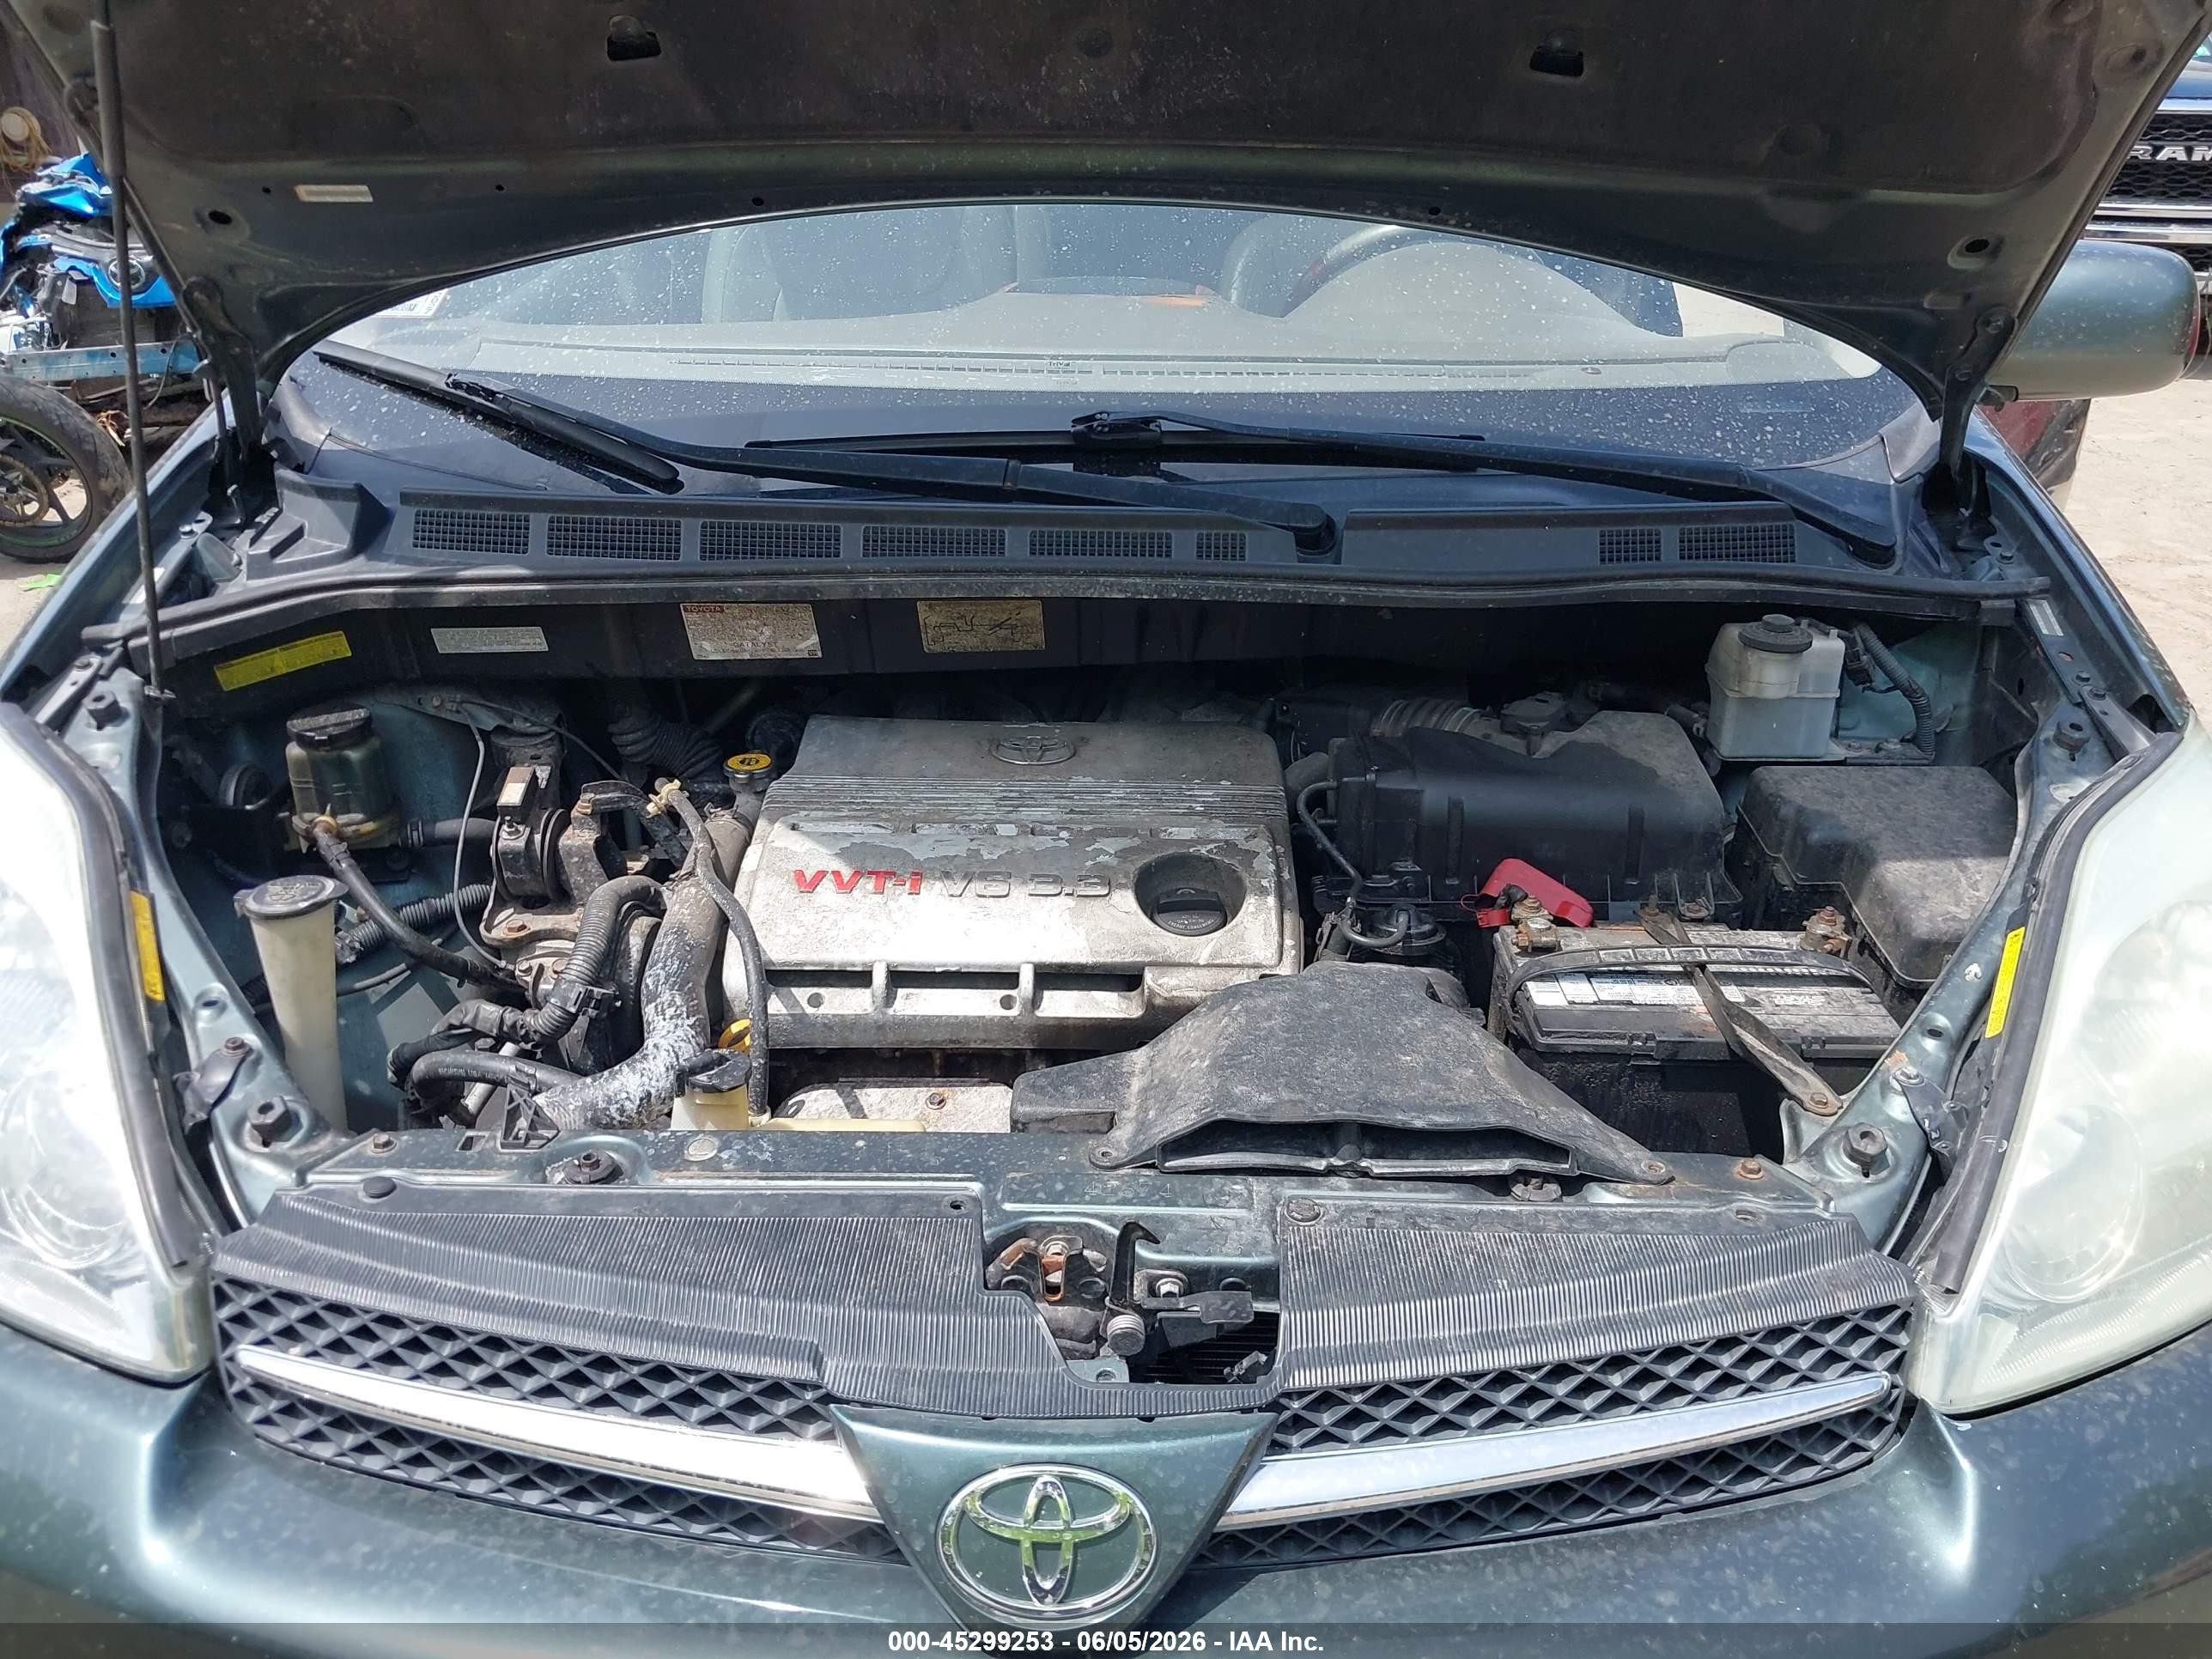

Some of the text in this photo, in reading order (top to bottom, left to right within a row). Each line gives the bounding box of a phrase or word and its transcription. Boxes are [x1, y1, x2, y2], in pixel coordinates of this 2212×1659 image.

[793, 869, 1111, 898] VVT-i V6 3.3
